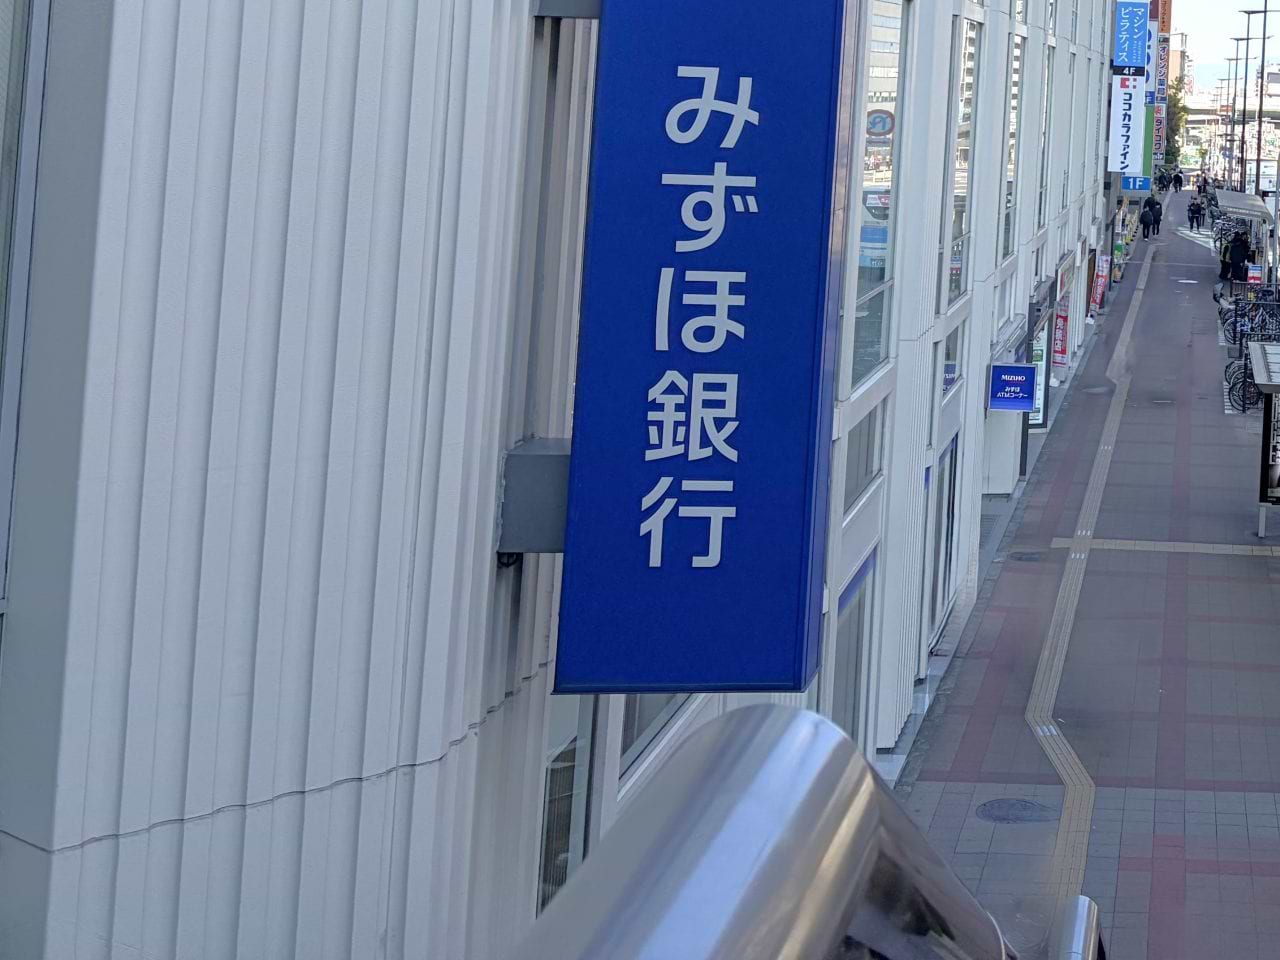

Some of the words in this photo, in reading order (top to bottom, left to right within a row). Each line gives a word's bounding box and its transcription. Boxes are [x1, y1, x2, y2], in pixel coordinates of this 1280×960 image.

[1118, 7, 1132, 62] ピラティス
[1133, 7, 1145, 39] マシン
[1119, 93, 1133, 170] ココカラファイン
[1128, 177, 1145, 189] 1F
[640, 66, 760, 568] みずほ銀行
[1001, 374, 1026, 382] MIZUHO
